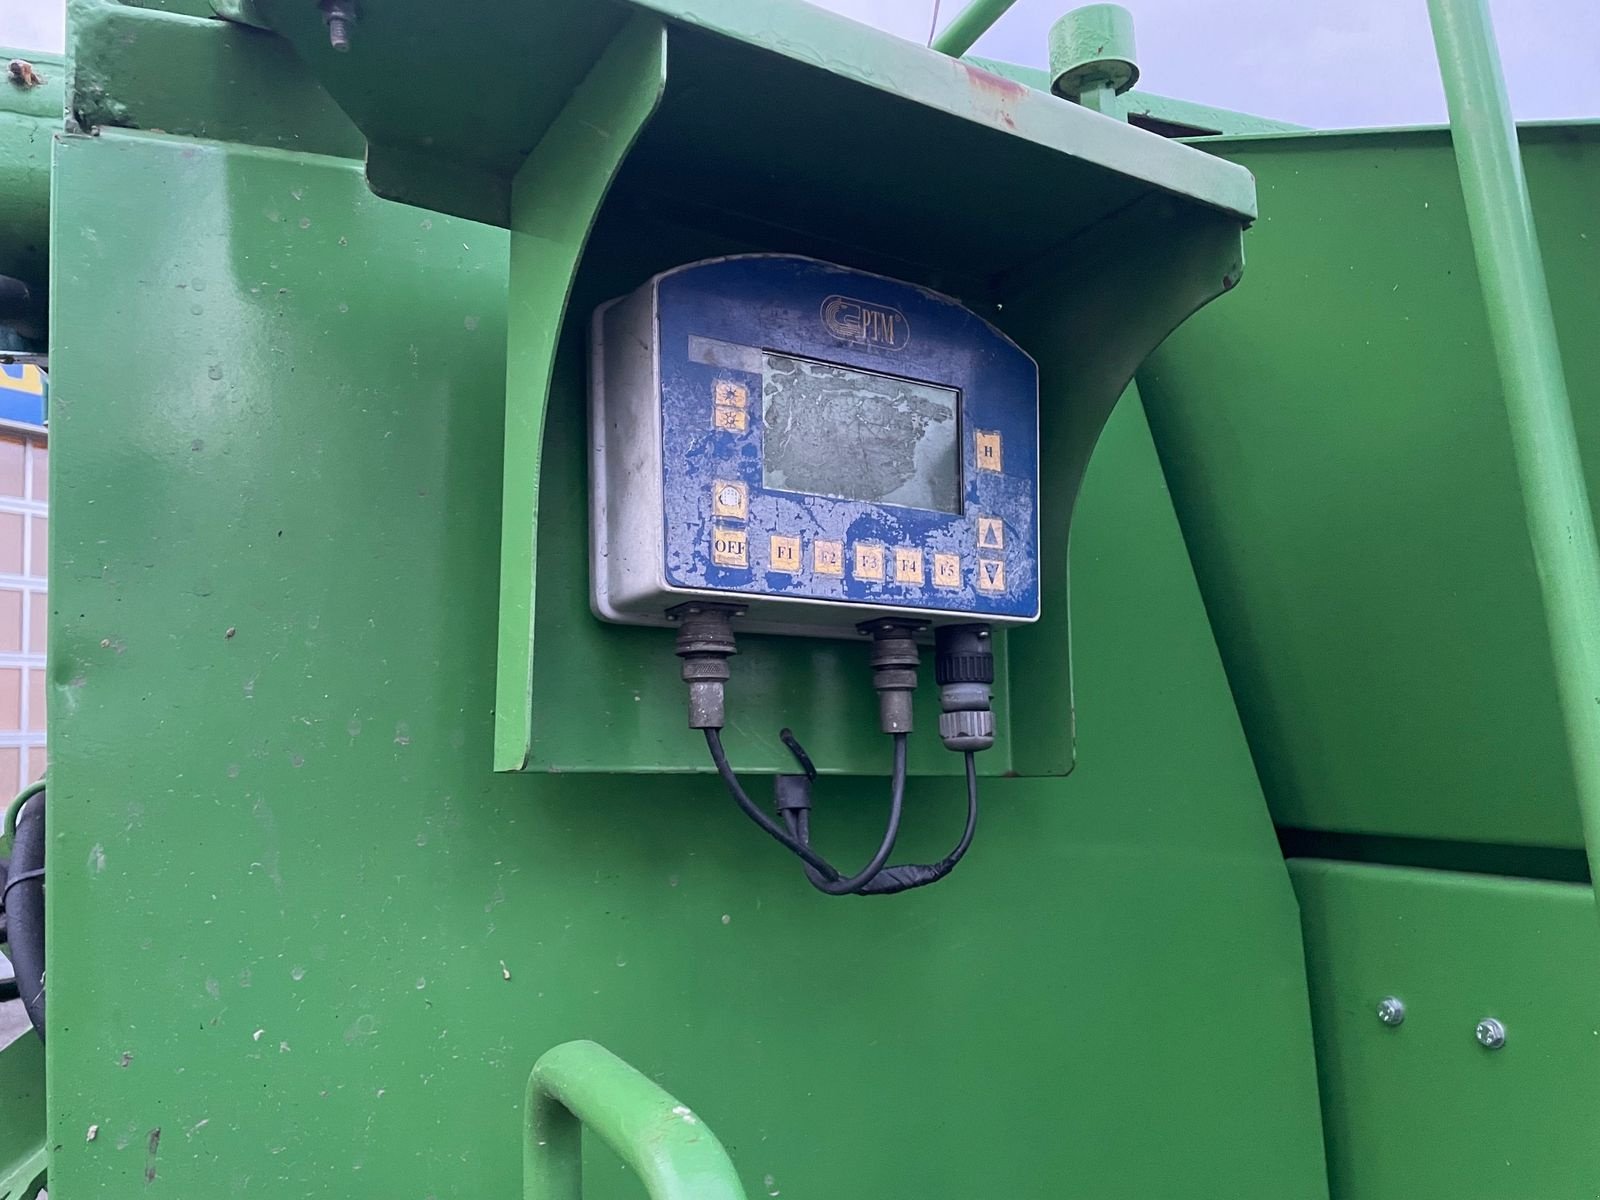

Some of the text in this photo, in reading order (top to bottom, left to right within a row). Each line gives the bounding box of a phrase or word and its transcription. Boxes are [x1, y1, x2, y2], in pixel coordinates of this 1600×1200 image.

[984, 445, 993, 458] H
[715, 539, 954, 577] OFF F1 F2 F3 F4 F5
